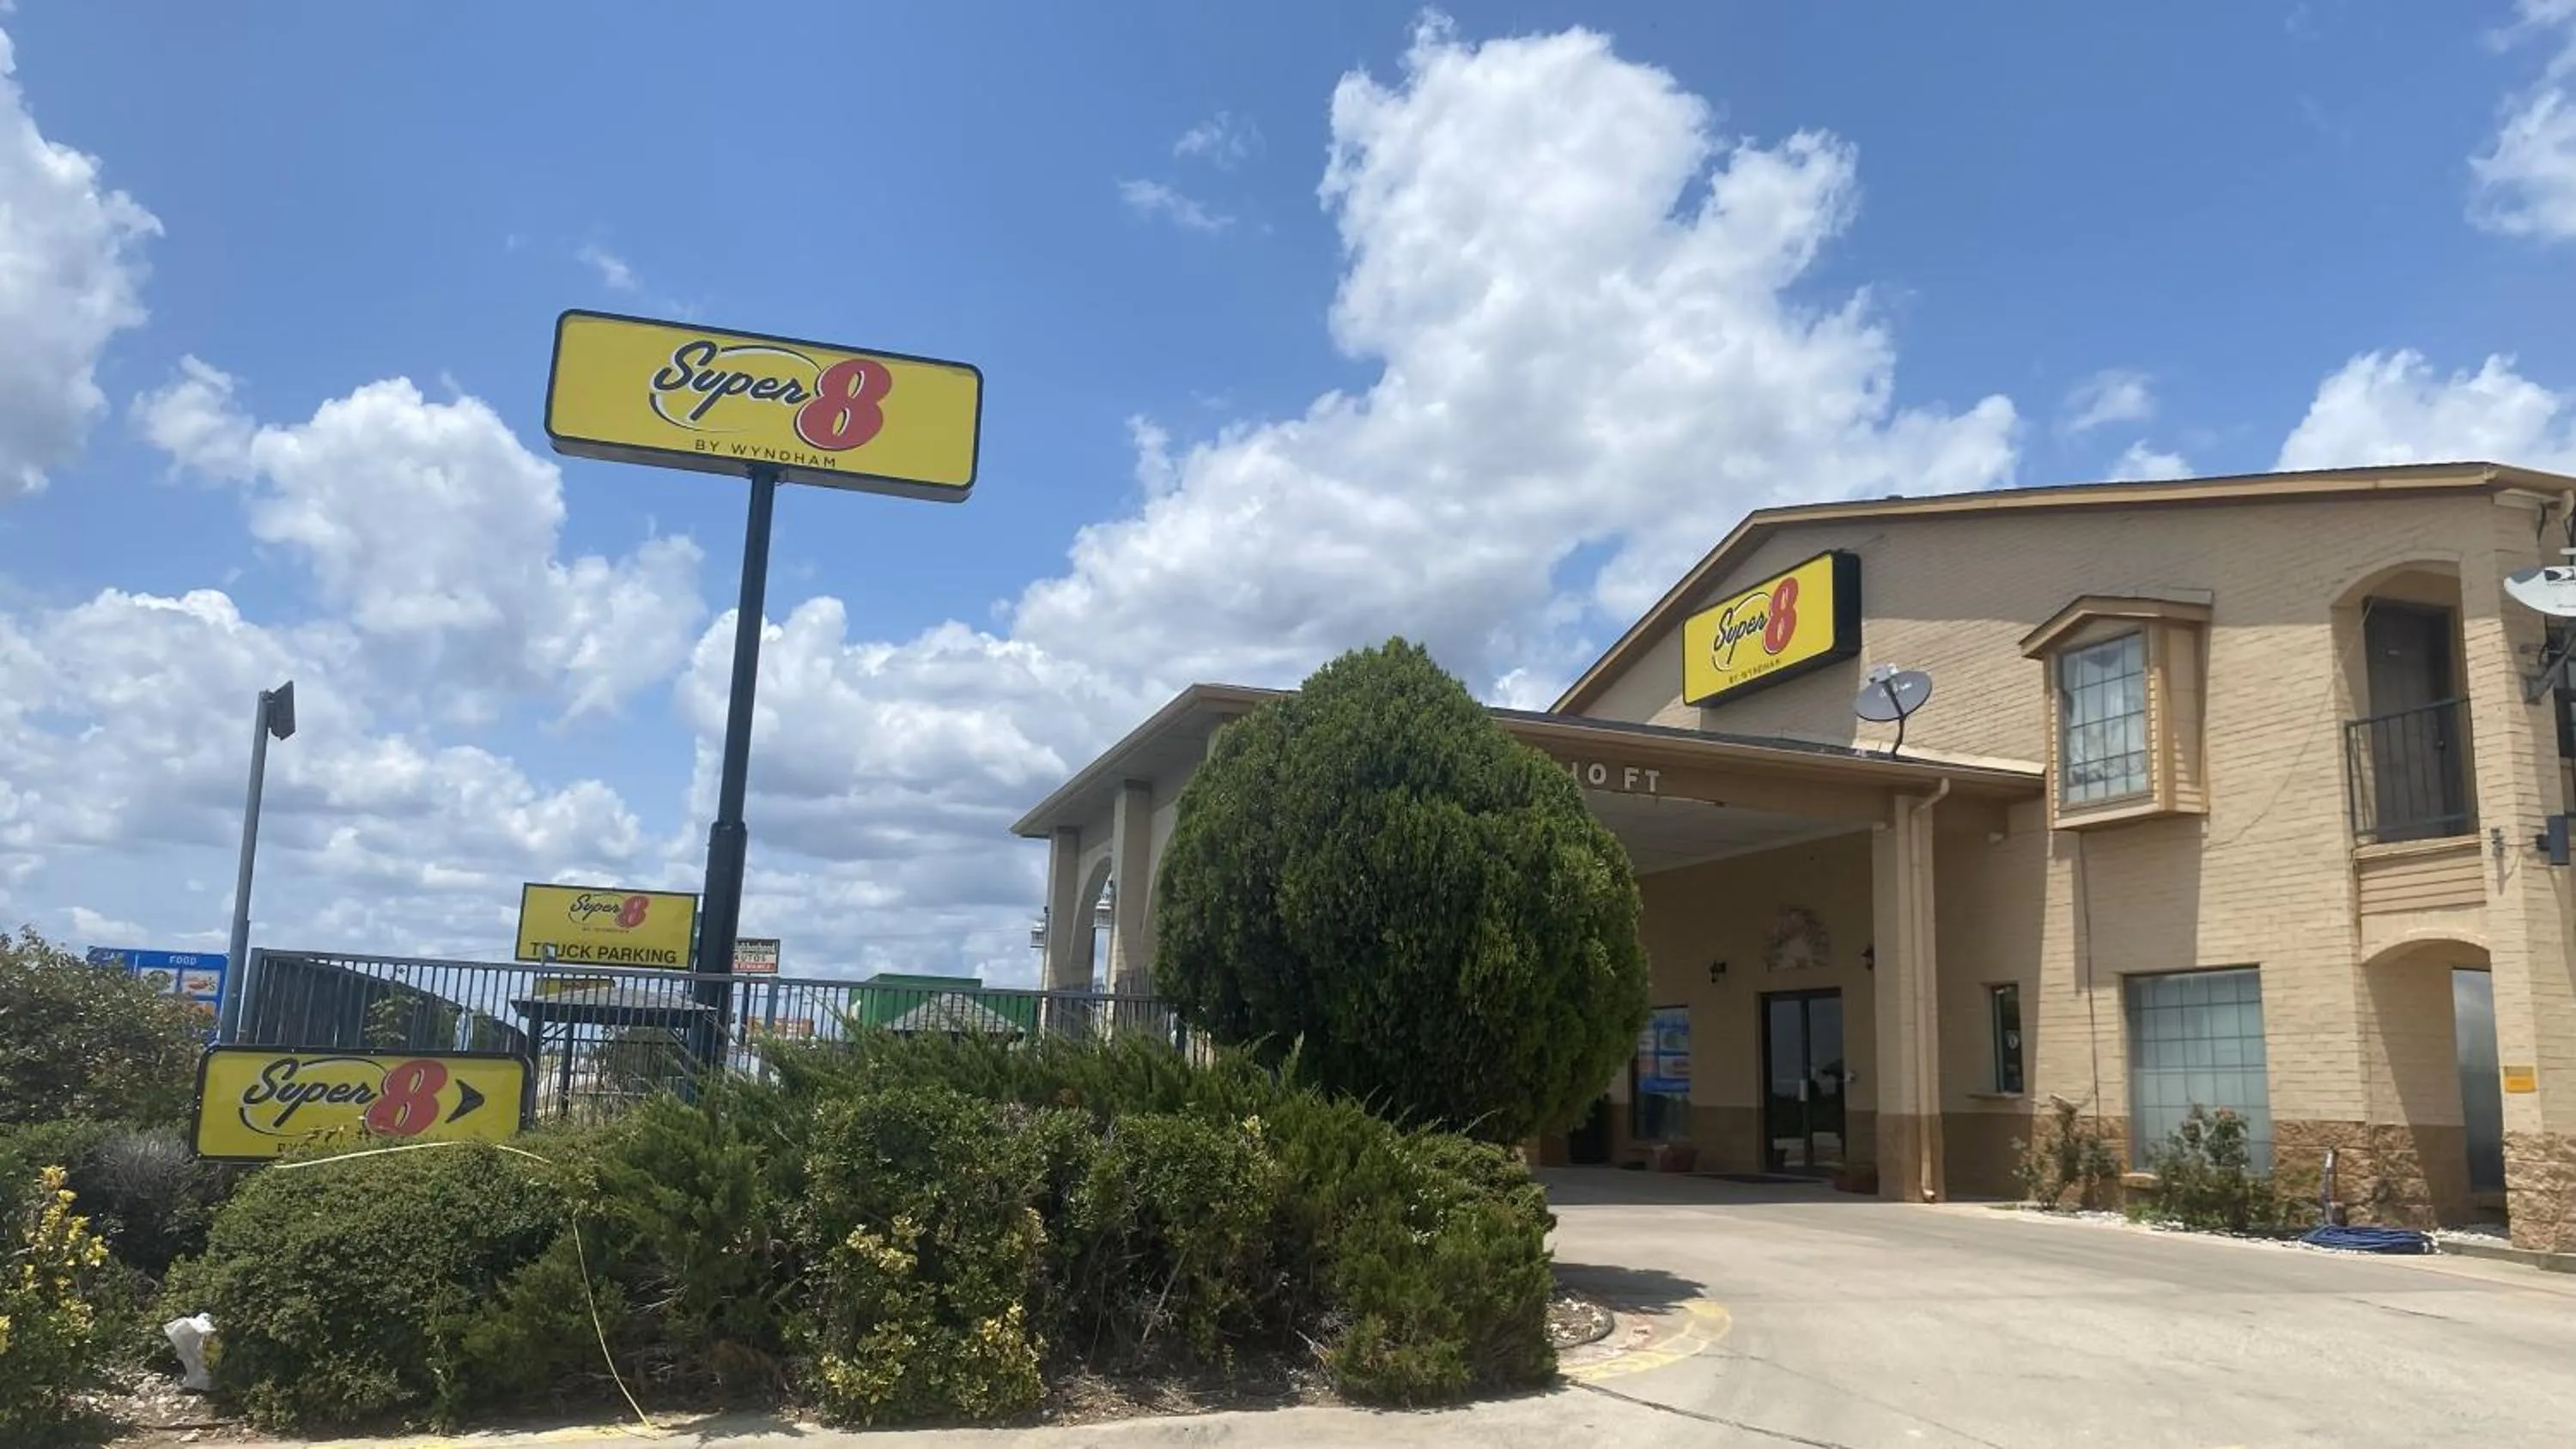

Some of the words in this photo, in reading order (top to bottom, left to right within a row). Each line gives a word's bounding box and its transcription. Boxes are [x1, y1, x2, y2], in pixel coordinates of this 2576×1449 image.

[653, 341, 811, 421] Super
[793, 358, 893, 451] 8
[695, 440, 720, 452] BY
[731, 445, 836, 468] WYNDHAM
[1713, 607, 1768, 665] Super
[1763, 577, 1799, 655] 8
[1624, 767, 1660, 792] FT
[569, 894, 621, 922] Super
[615, 895, 650, 928] 8
[169, 955, 197, 966] FOOD
[531, 942, 593, 960] TUCK
[598, 946, 677, 965] PARKING
[243, 1058, 378, 1128] Super
[364, 1059, 447, 1137] 8
